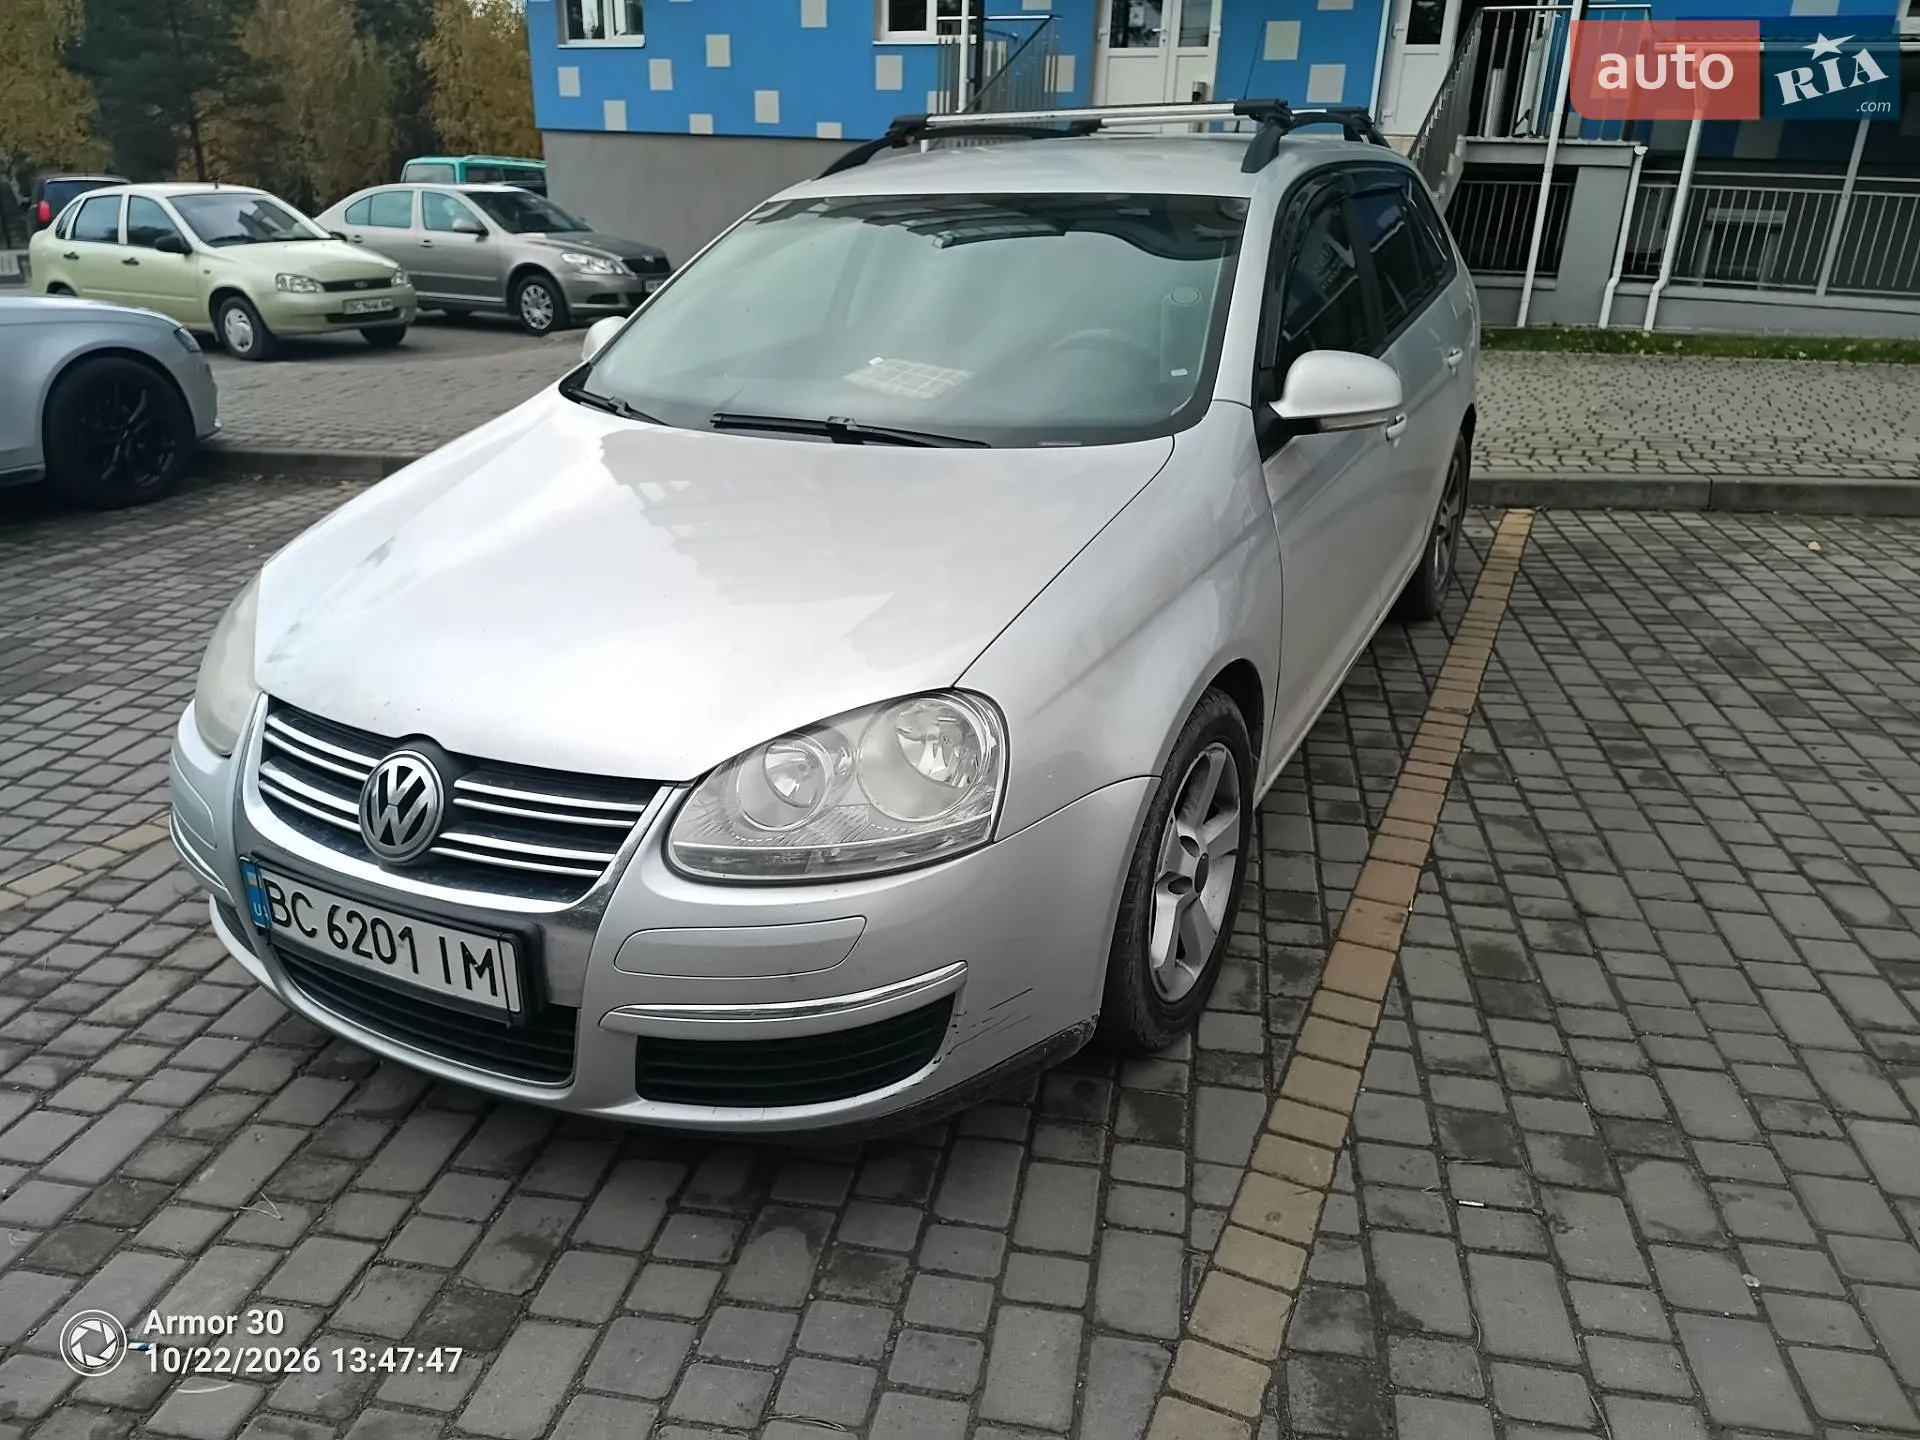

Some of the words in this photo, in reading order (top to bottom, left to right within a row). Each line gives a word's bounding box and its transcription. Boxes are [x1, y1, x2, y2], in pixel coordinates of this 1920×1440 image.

[366, 756, 437, 854] VW
[262, 877, 318, 938] BC
[327, 904, 420, 975] 6201
[438, 936, 498, 997] IM
